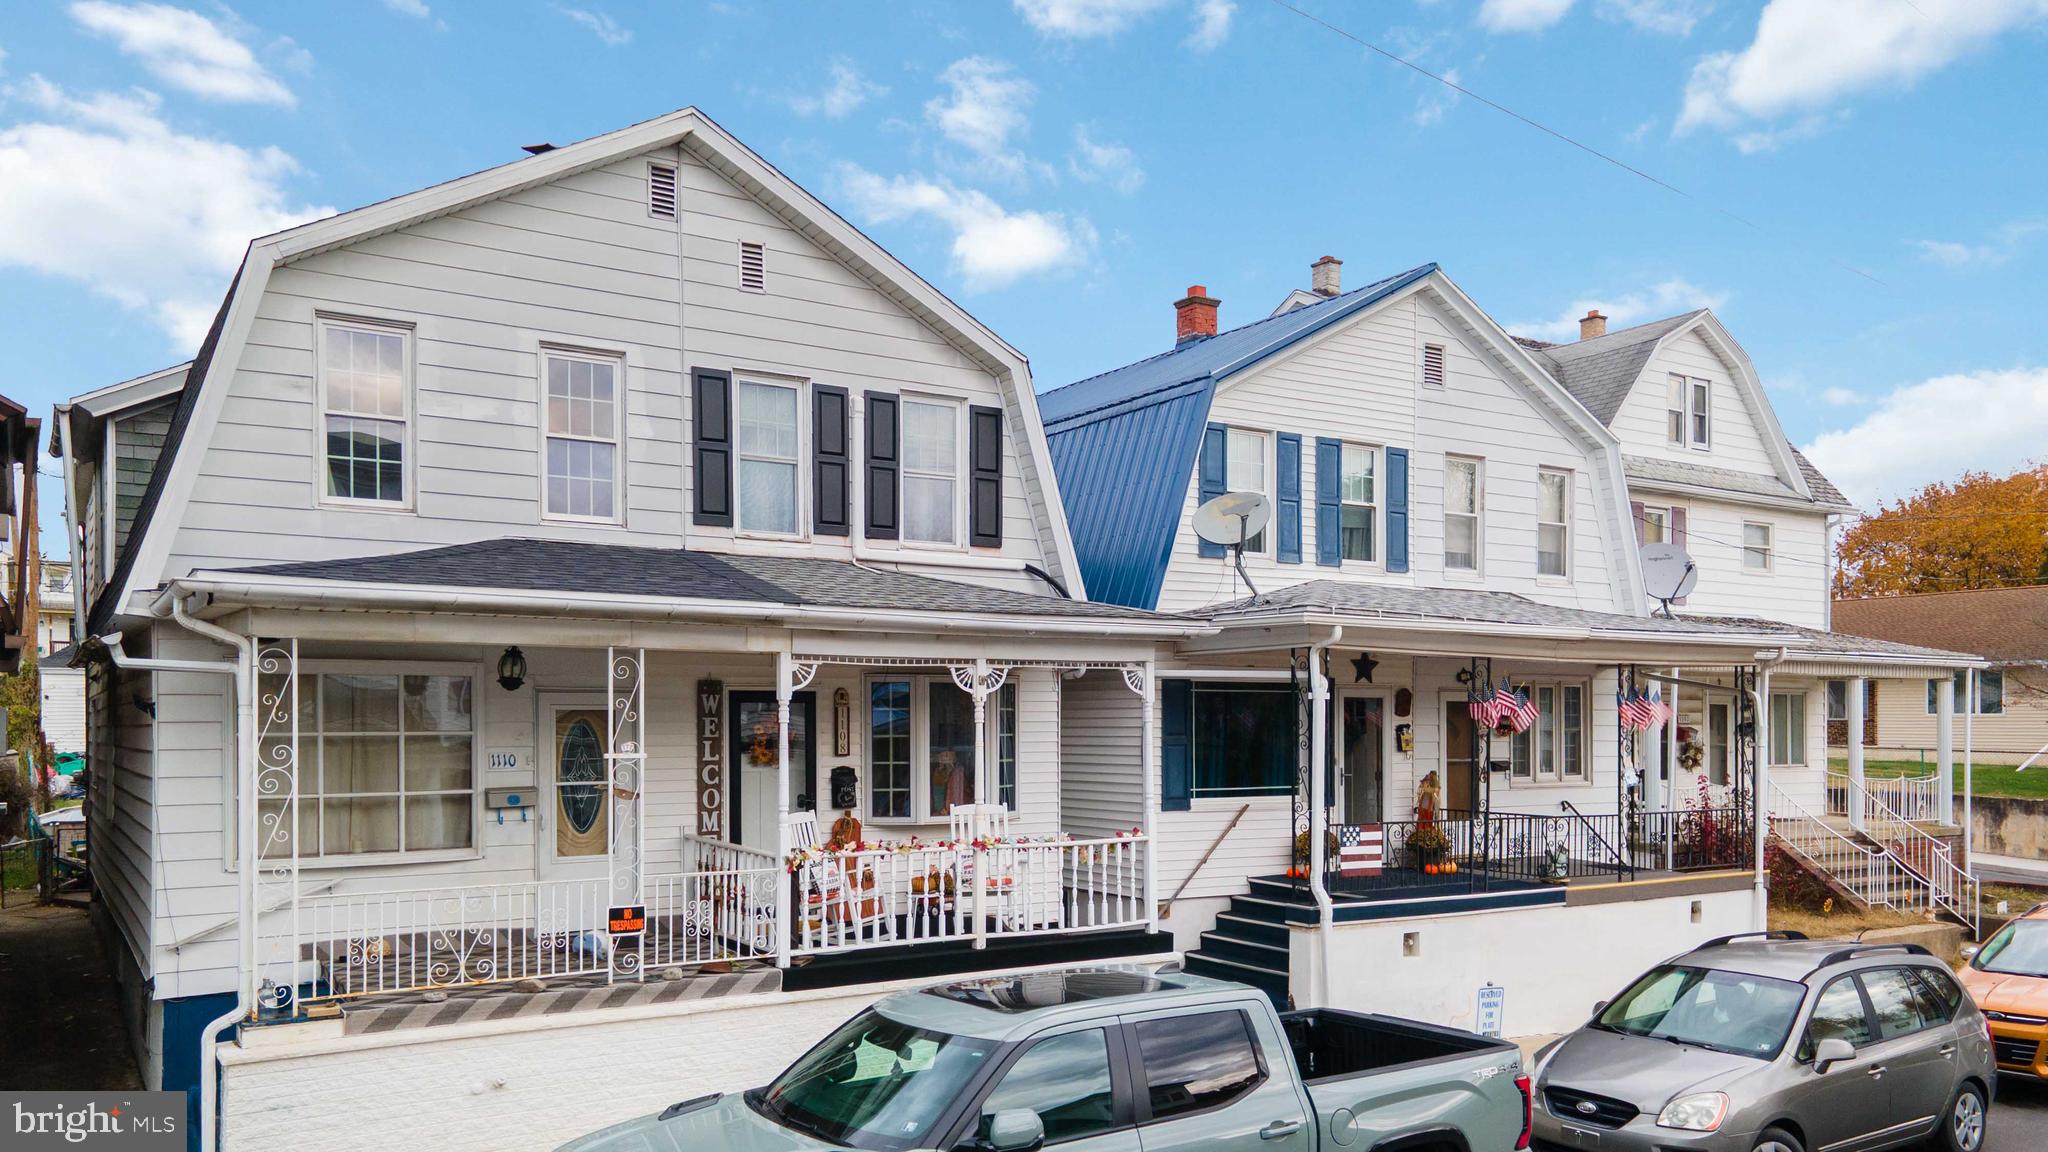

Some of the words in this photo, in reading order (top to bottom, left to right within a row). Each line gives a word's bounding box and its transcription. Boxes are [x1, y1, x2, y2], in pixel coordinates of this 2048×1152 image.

[491, 753, 516, 768] 1110
[701, 693, 721, 839] WELCOM
[610, 918, 644, 931] TRESPASSING
[1480, 990, 1502, 998] RESERVED
